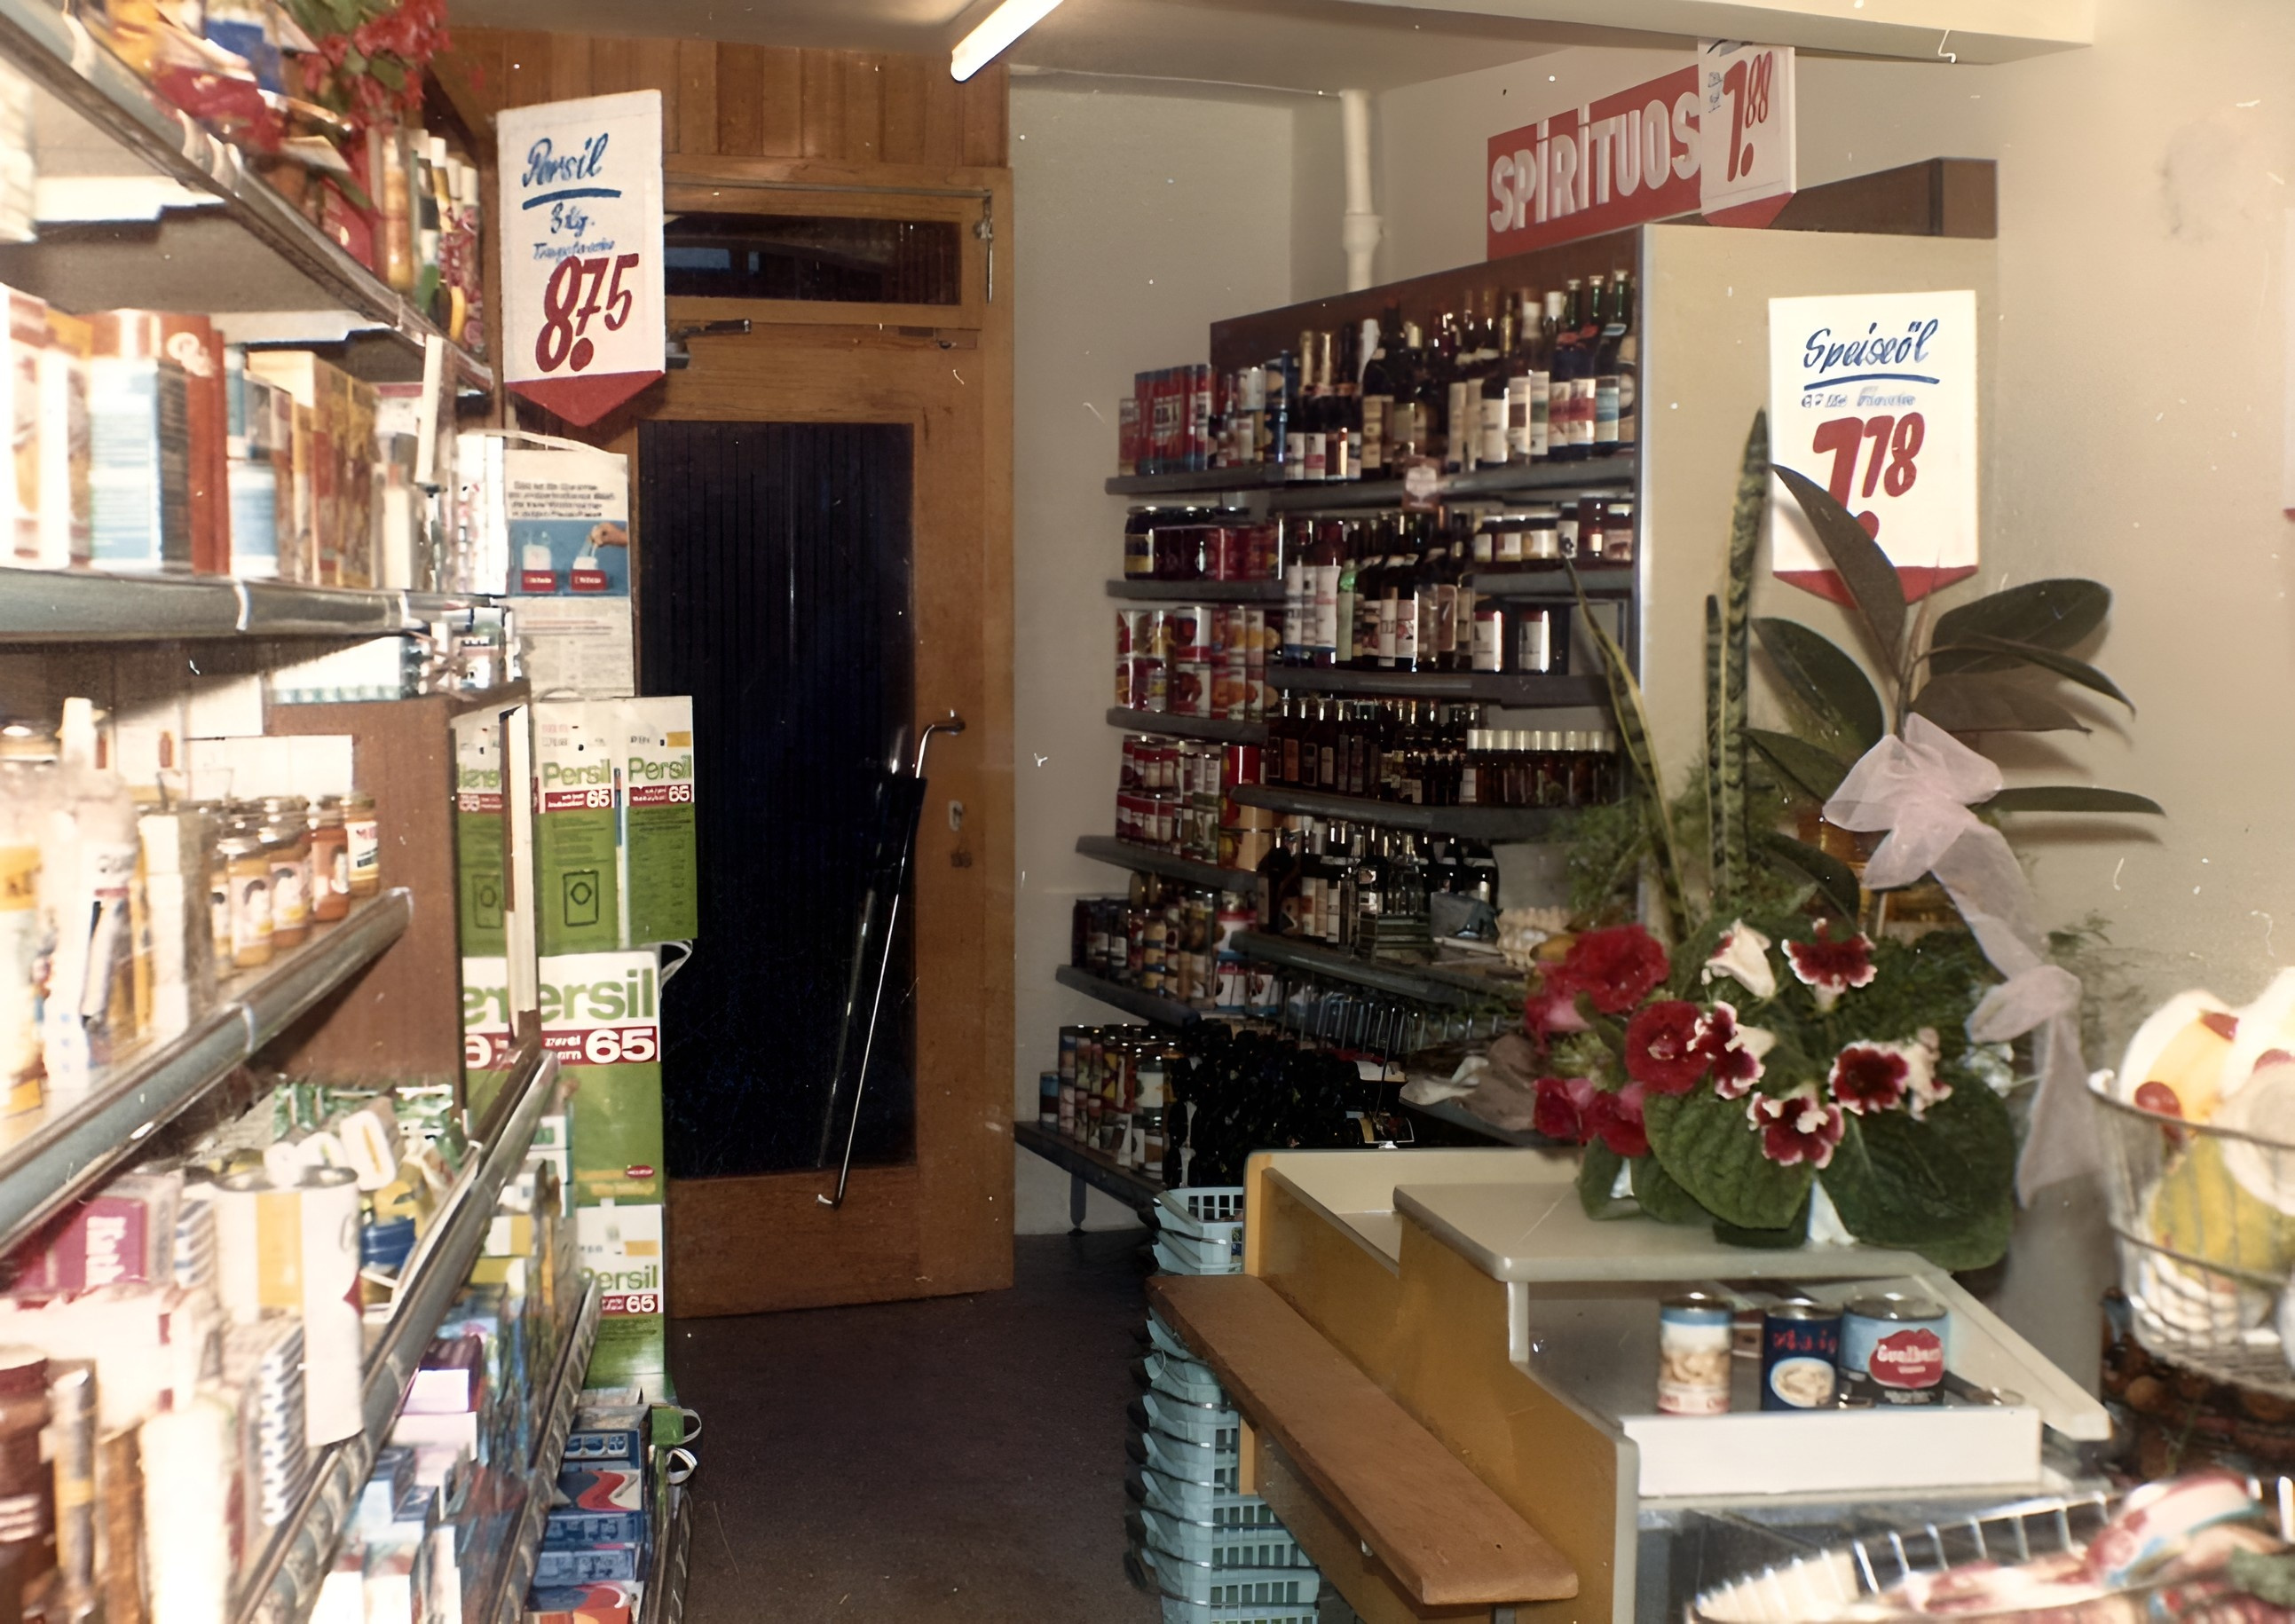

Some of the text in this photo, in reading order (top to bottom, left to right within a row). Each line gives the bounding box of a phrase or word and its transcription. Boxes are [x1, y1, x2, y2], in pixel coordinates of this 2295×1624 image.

[522, 132, 610, 187] Persil
[1803, 318, 1939, 374] Speiseöl
[542, 758, 611, 787] Persil
[628, 754, 692, 783] Persil
[586, 789, 611, 808] 65
[668, 784, 690, 802] 65
[539, 967, 655, 1024] ersil
[585, 1027, 655, 1064] 65
